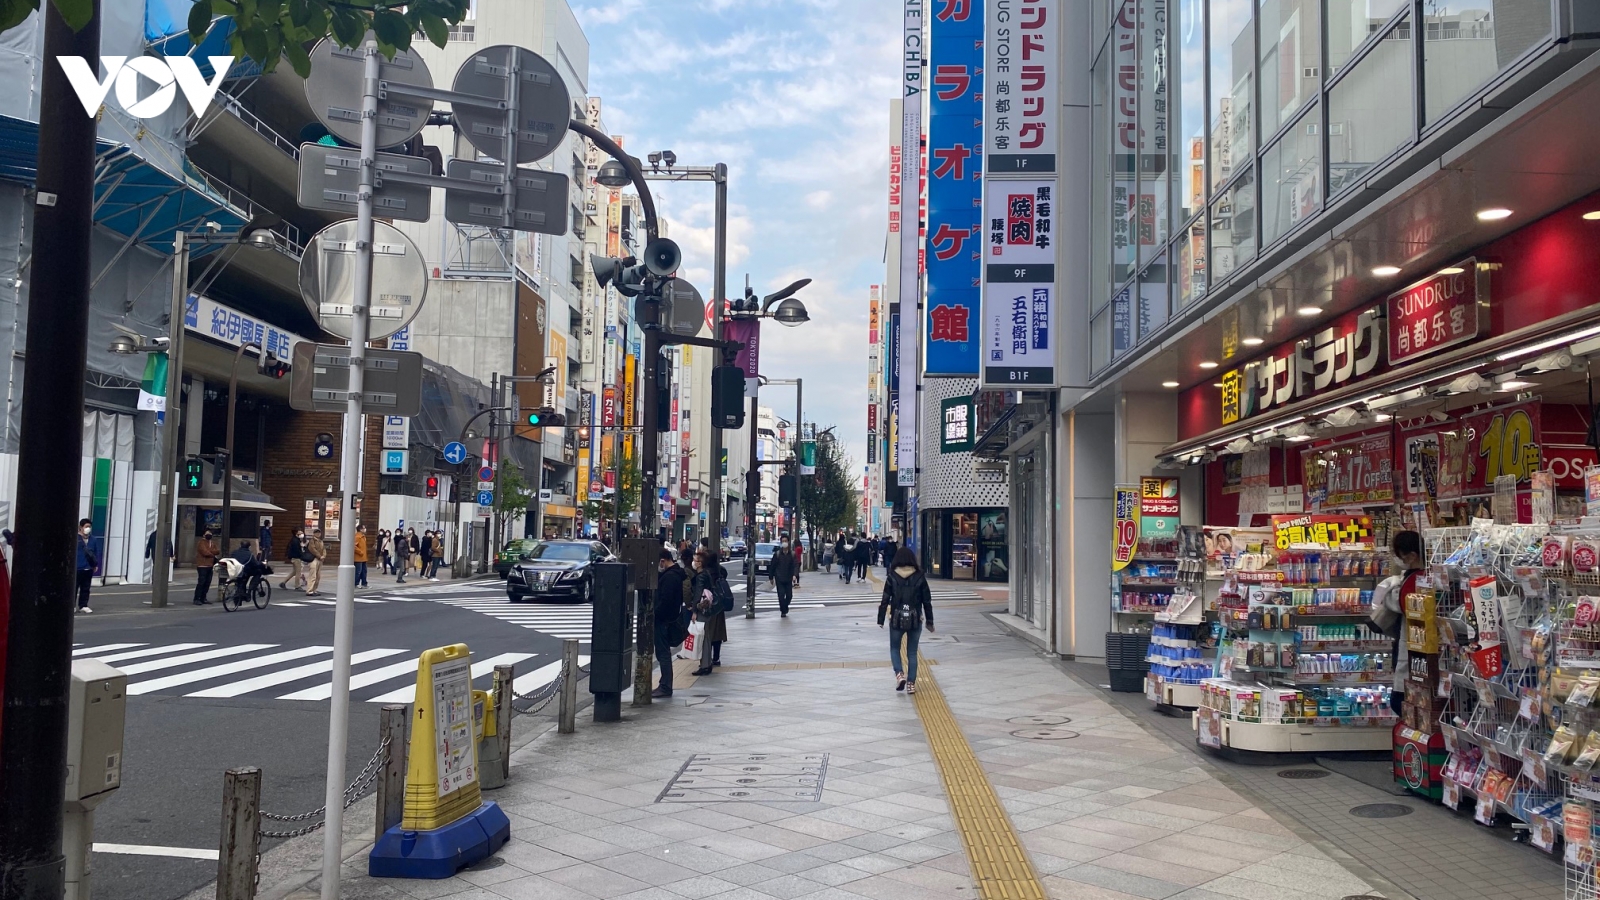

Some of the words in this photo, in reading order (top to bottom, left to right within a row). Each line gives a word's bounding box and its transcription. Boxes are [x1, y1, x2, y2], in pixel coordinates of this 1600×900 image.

[905, 27, 921, 97] ICHIBA
[997, 28, 1010, 73] STORE
[1019, 0, 1047, 149] ンドラッグ
[930, 0, 972, 343] カラオケ館
[1015, 158, 1028, 168] 1F
[991, 218, 1004, 245] 腰塚
[1009, 197, 1032, 242] 焼肉
[1035, 186, 1051, 249] 黒毛和牛
[1014, 269, 1026, 278] 9F
[1033, 290, 1047, 313] 元祖
[1397, 276, 1465, 320] SUNDRUG
[211, 306, 290, 360] 紀伊國屋書店
[1012, 295, 1028, 355] 五右衛門
[1397, 304, 1466, 354] 尚都乐客
[749, 336, 757, 358] TOKYO
[1257, 304, 1382, 410] サンドラッグ
[1009, 371, 1029, 381] B1F
[605, 398, 613, 423] ガスト
[1145, 480, 1160, 496] 薬
[1364, 471, 1380, 488] OFF
[1142, 505, 1178, 513] サンドラッグ
[1276, 518, 1368, 550] お買い得コーナー
